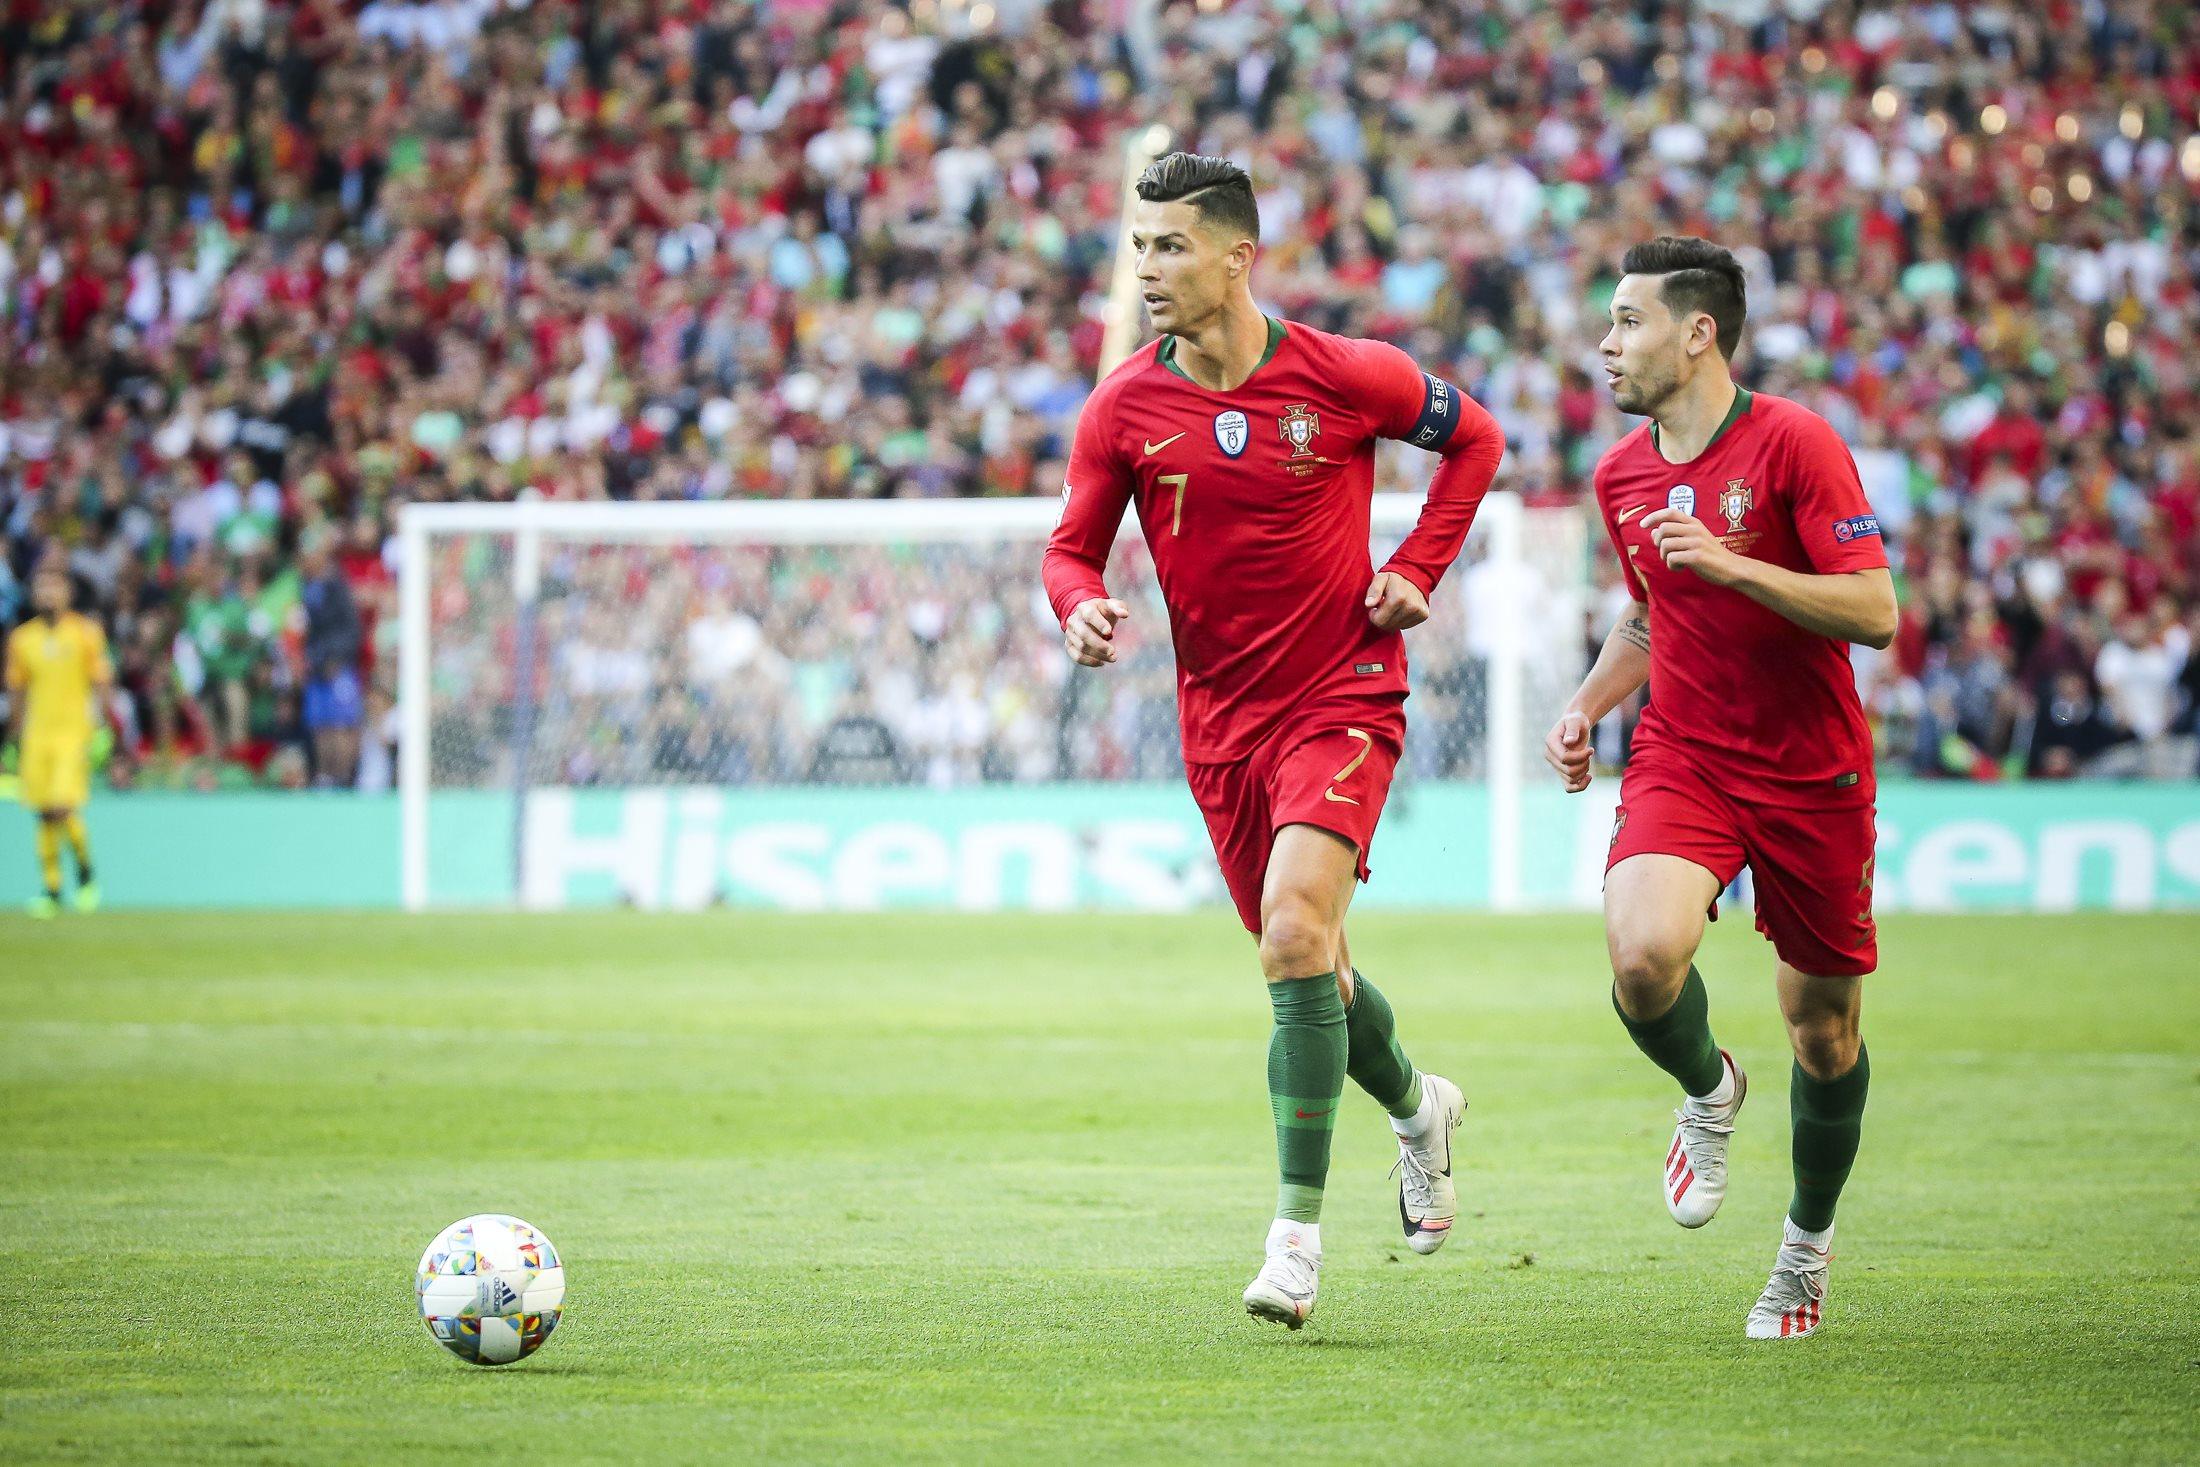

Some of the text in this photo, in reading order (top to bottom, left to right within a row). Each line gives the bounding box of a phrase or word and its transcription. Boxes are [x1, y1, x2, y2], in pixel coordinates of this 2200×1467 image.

[1157, 473, 1189, 537] 7
[1332, 727, 1374, 784] 7
[524, 784, 1222, 912] Hisens
